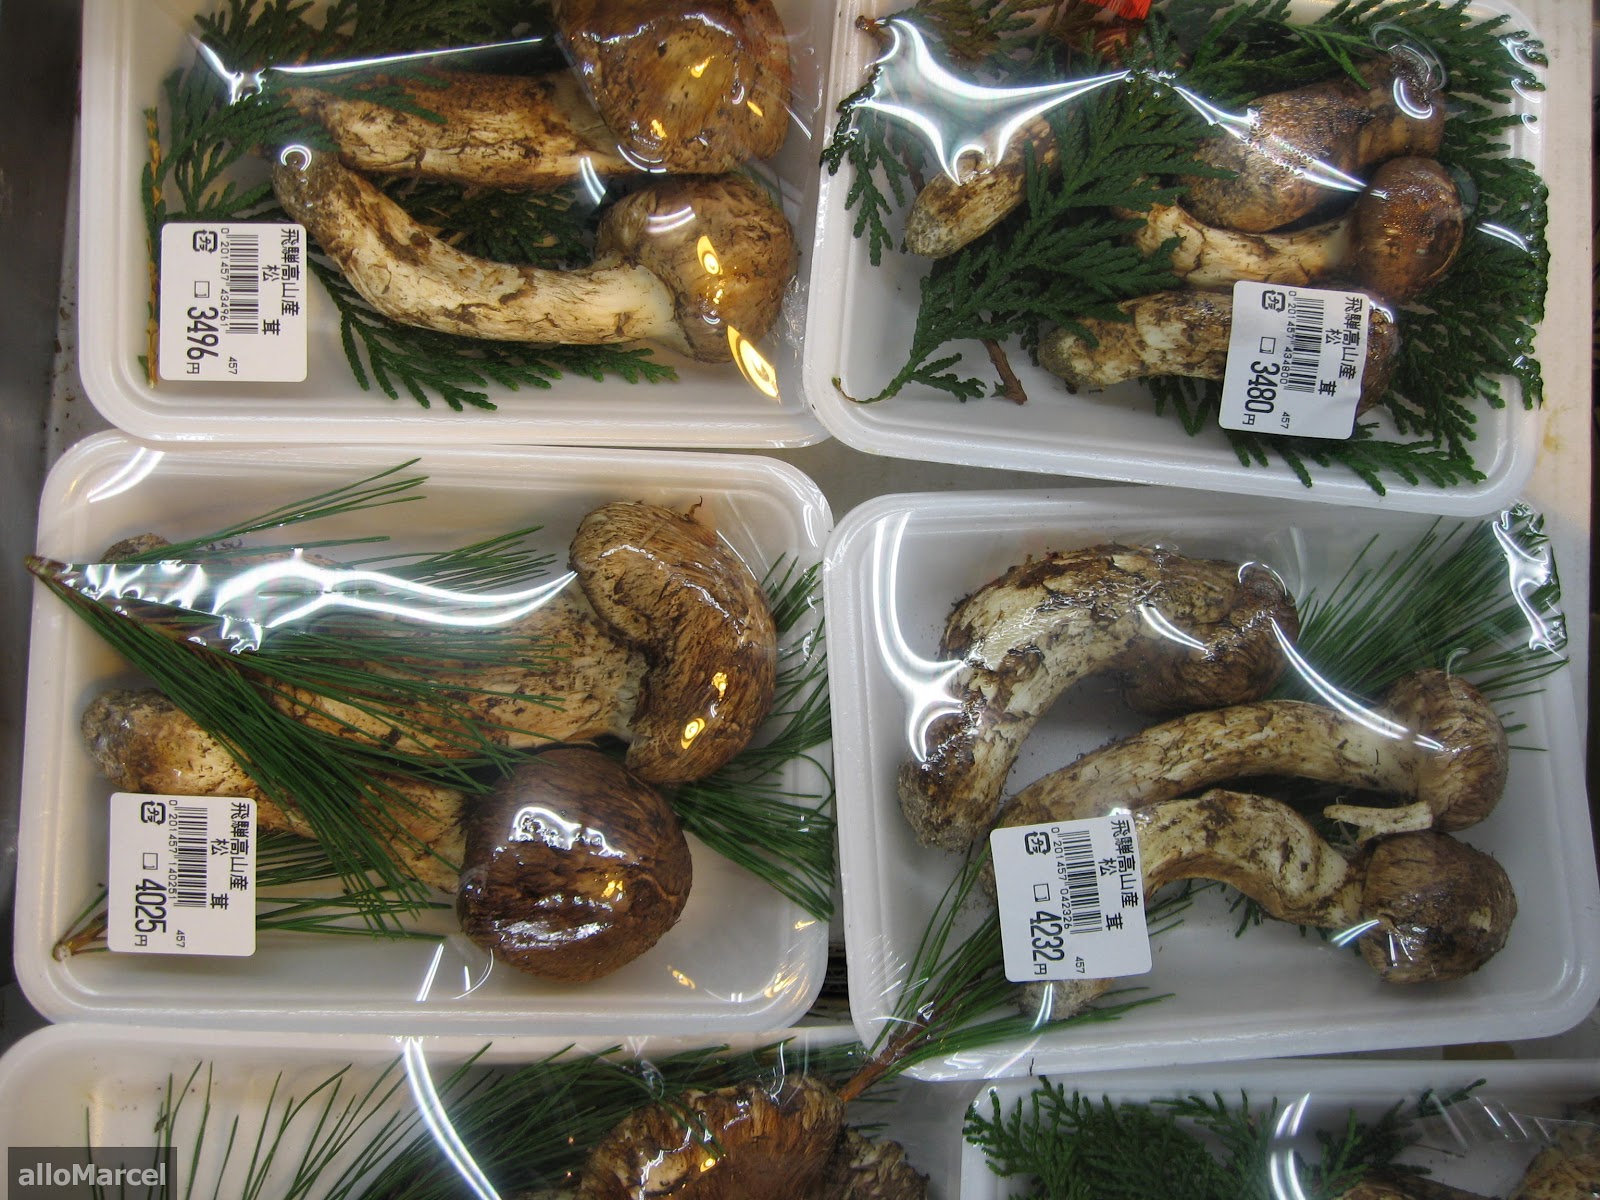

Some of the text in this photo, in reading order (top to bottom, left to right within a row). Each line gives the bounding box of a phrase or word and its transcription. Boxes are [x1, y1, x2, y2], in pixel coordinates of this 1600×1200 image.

[281, 228, 300, 316] 飛騨高山産
[1339, 297, 1362, 380] 飛騨高山産
[229, 357, 237, 375] 457
[1281, 412, 1290, 429] 457
[230, 802, 250, 891] 飛騨高山産
[1111, 820, 1138, 908] 飛騨高山産
[176, 930, 185, 948] 457
[1075, 956, 1085, 973] 457
